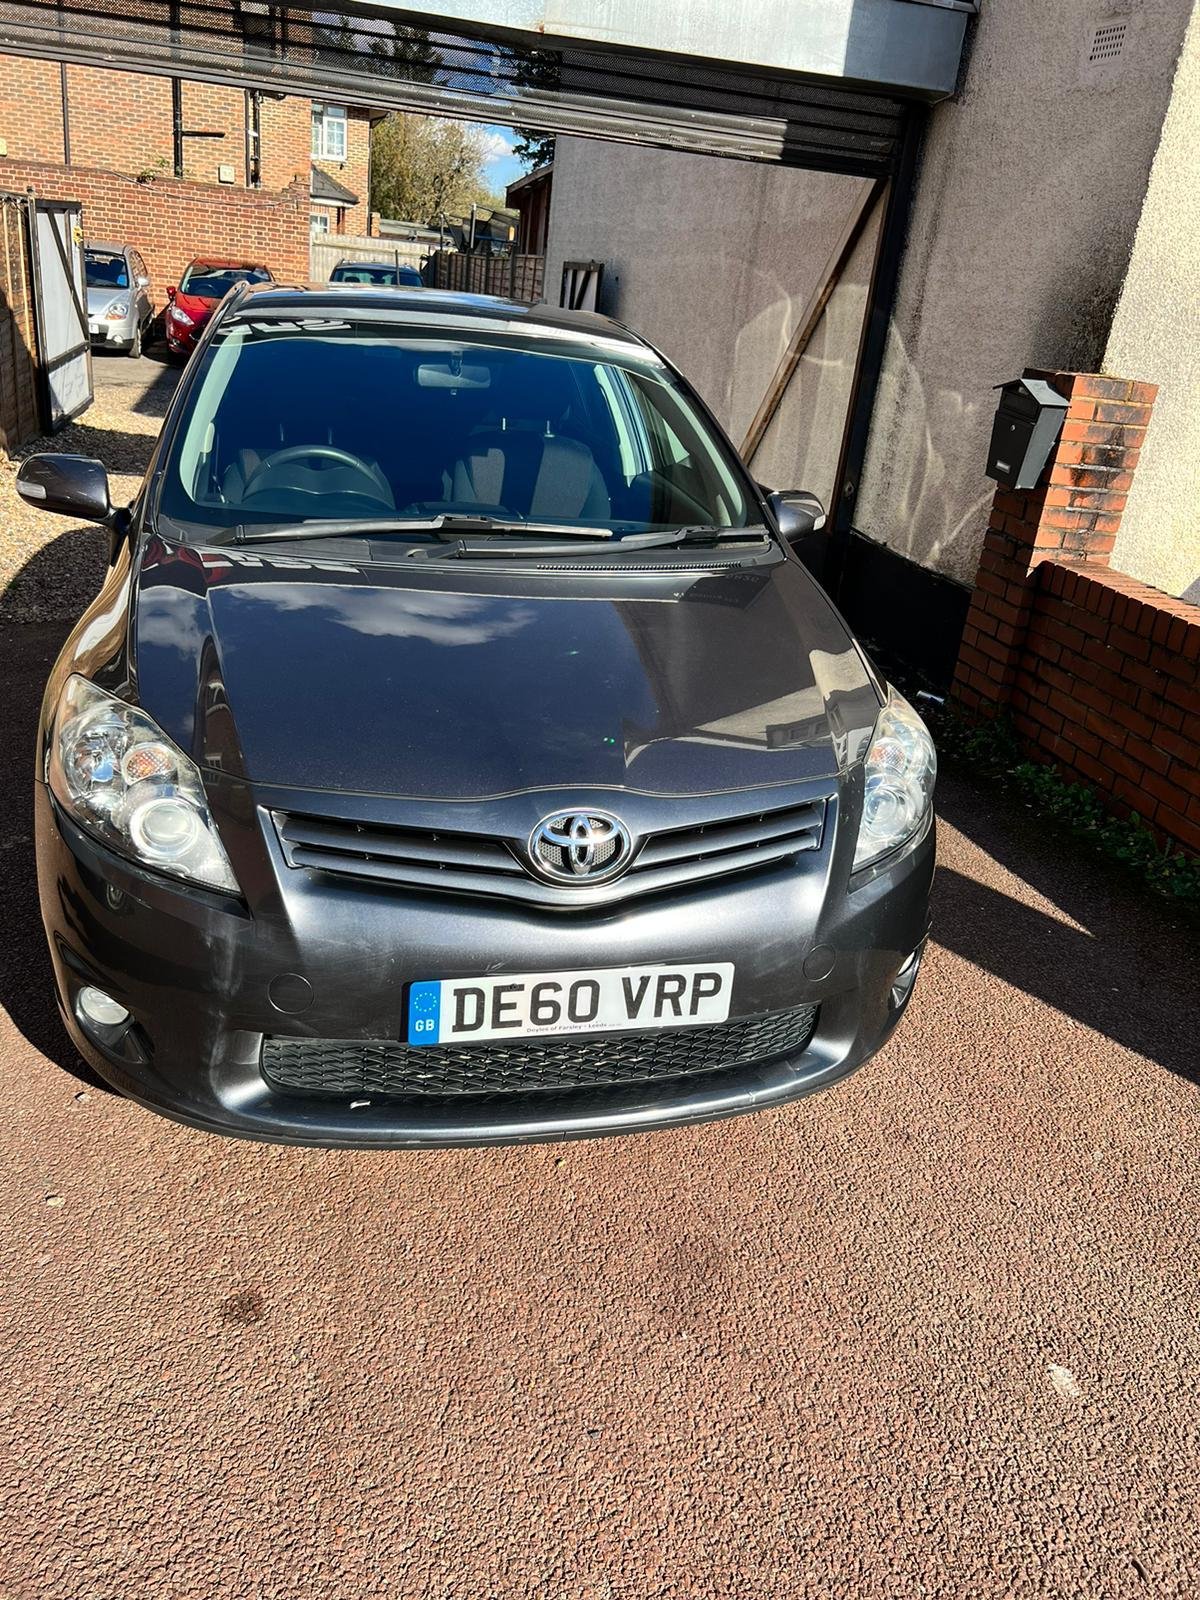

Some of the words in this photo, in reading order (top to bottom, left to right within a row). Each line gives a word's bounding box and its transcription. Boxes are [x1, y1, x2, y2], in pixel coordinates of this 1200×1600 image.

[452, 979, 601, 1033] DE60
[621, 972, 723, 1019] VRP
[415, 1019, 435, 1032] GB
